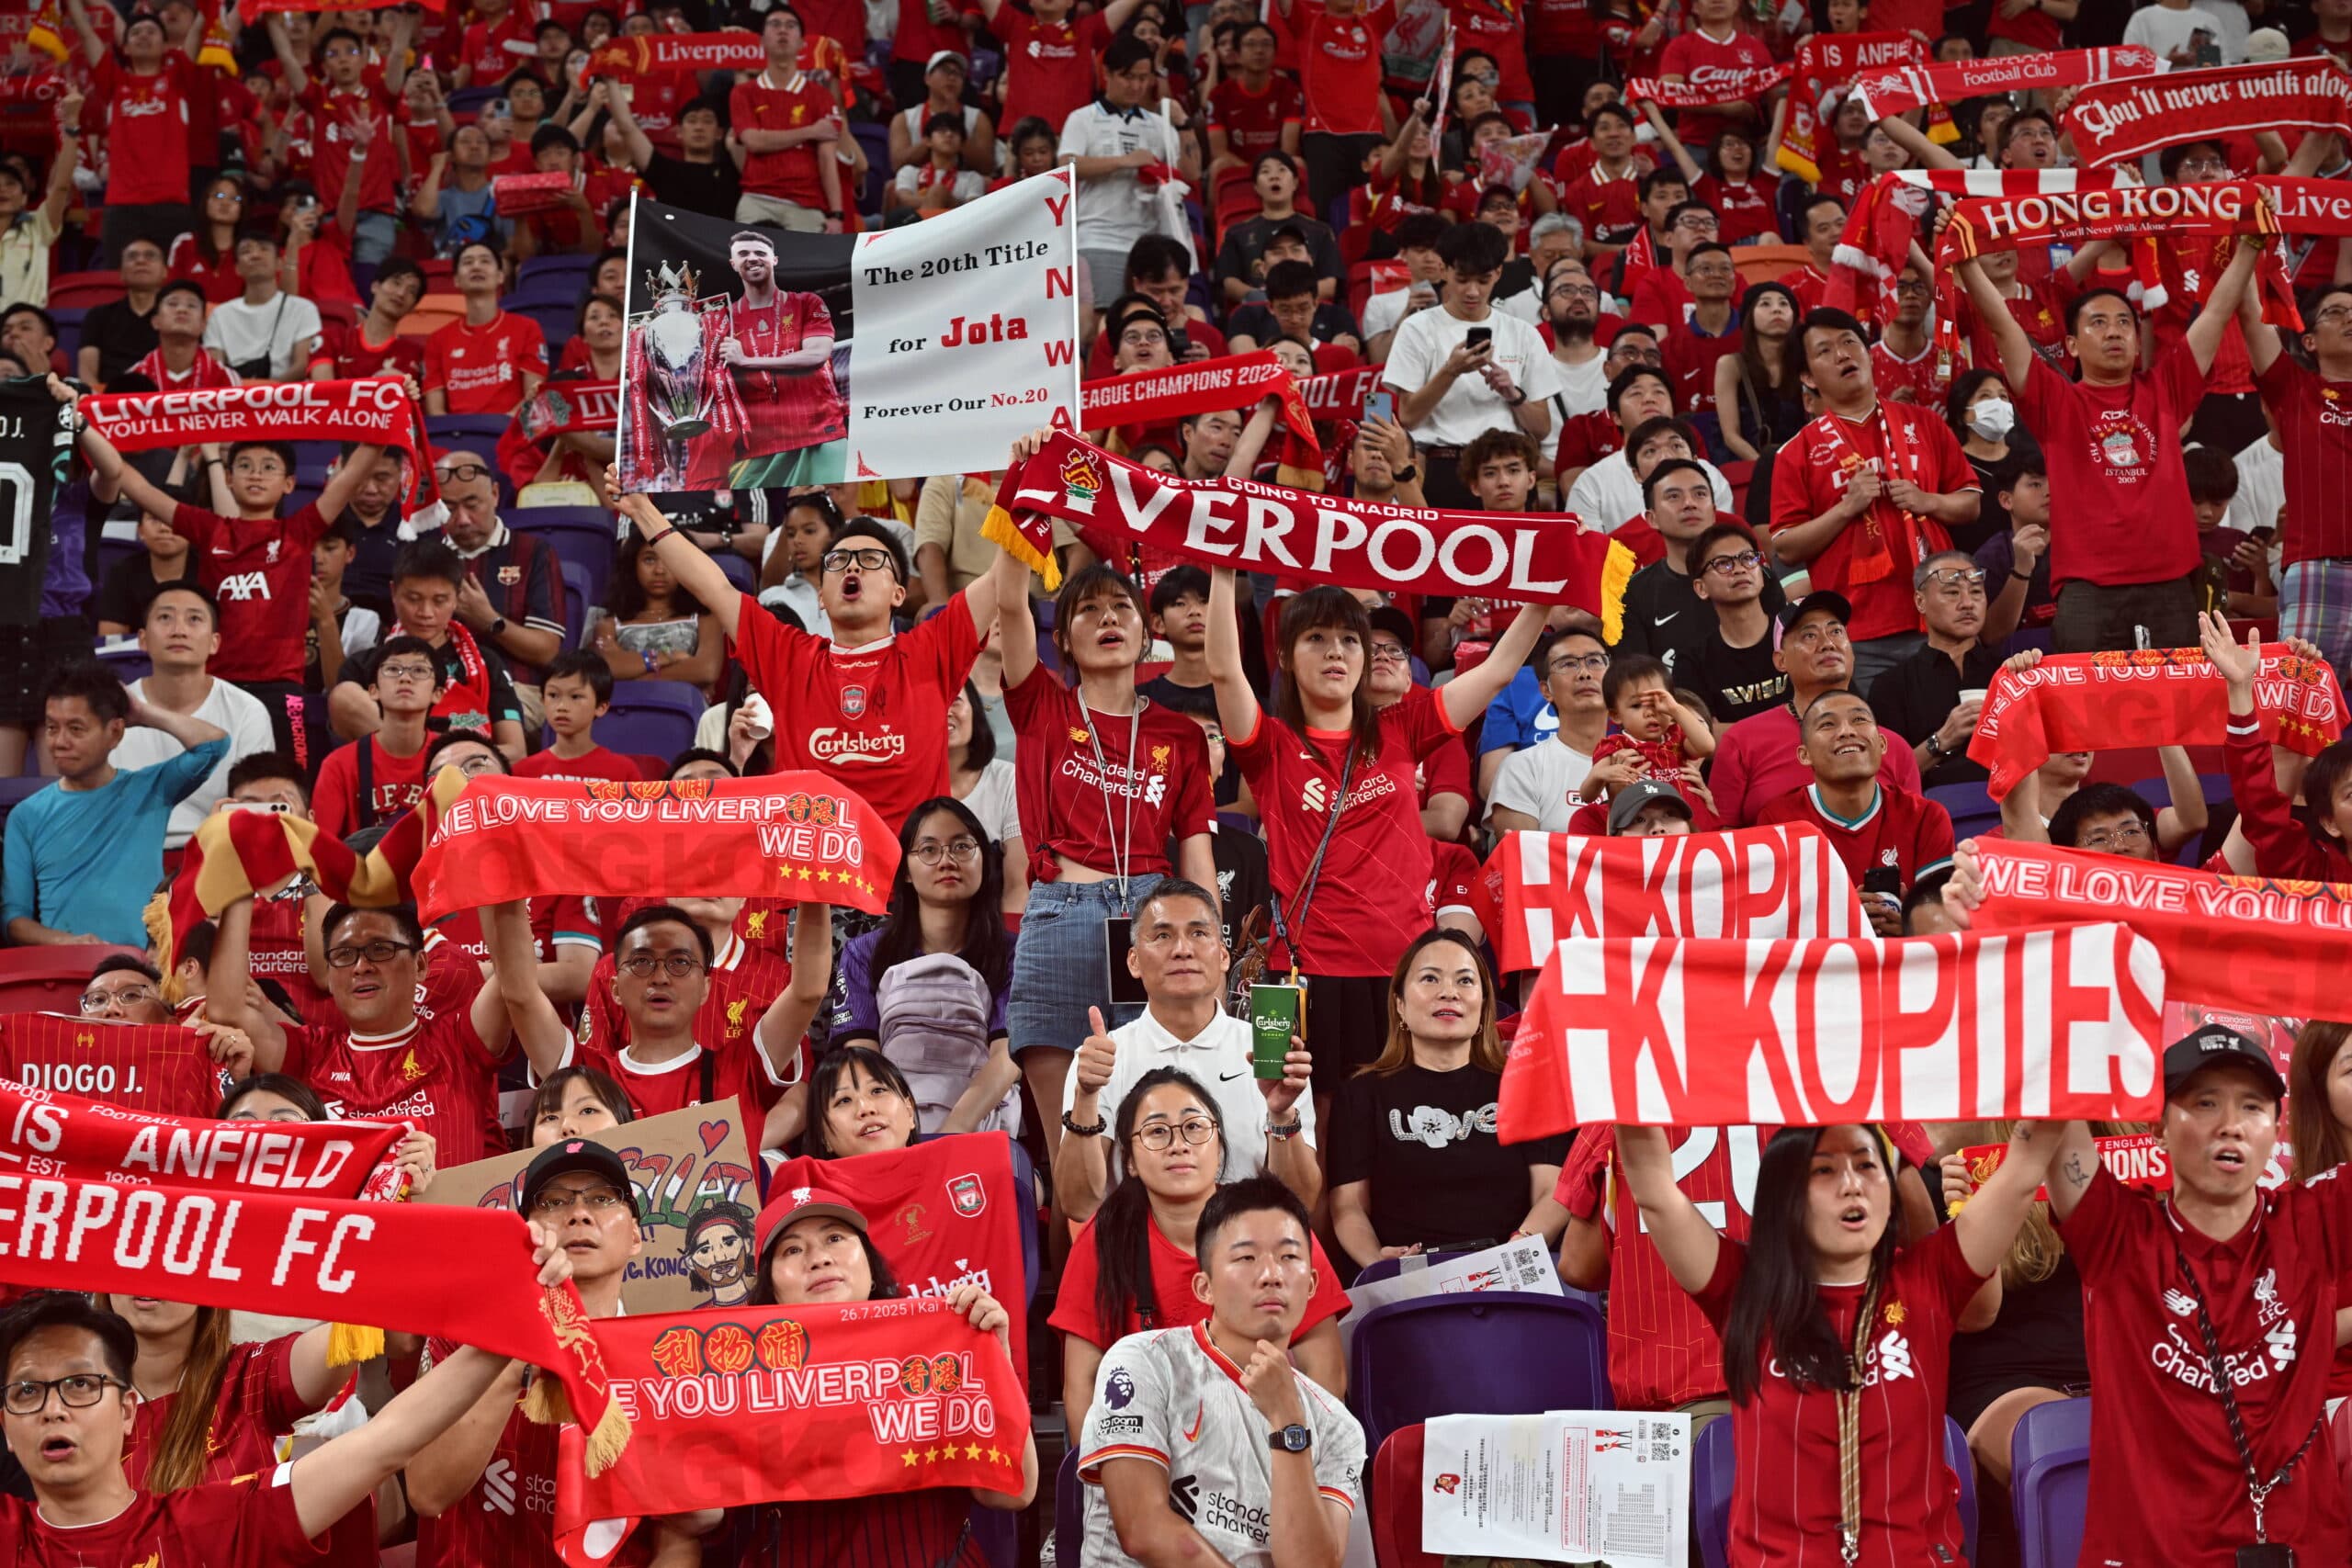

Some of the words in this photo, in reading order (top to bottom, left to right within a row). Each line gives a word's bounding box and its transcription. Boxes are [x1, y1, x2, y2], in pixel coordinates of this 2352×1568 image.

[1823, 45, 1842, 67] IS
[1962, 63, 2021, 86] Football
[2023, 62, 2057, 79] Club
[2073, 85, 2163, 147] You'll
[2164, 81, 2232, 109] never
[2237, 70, 2299, 100] walk
[1980, 192, 2110, 241] HONG
[2120, 186, 2241, 221] KONG
[2085, 224, 2113, 235] Never
[2114, 221, 2138, 233] Walk
[2139, 220, 2166, 232] Alone
[865, 266, 914, 286] The
[921, 253, 978, 278] 20th
[985, 241, 1049, 266] Title
[888, 337, 927, 353] for
[941, 313, 1028, 348] Jota
[91, 382, 330, 423] LIVERPOOL
[348, 380, 404, 411] FC
[864, 402, 944, 419] Forever
[948, 398, 986, 412] Our
[990, 388, 1048, 407] No.20
[1081, 383, 1130, 410] EAGUE
[1134, 368, 1231, 400] CHAMPIONS
[1238, 364, 1283, 386] 2025
[98, 414, 173, 439] YOU'LL
[180, 413, 245, 432] NEVER
[254, 409, 322, 426] WALK
[327, 410, 393, 429] ALONE
[2105, 468, 2148, 477] ISTANBUL
[1227, 477, 1297, 502] GOING
[1306, 494, 1337, 508] TO
[1347, 501, 1439, 522] MADRID
[1014, 459, 1568, 594] VERPOOL
[217, 570, 271, 601] AXA
[2255, 682, 2302, 713] WE
[808, 725, 905, 764] Carlsberg
[1062, 761, 1142, 798] Chartered
[477, 793, 570, 829] LOVE
[575, 798, 650, 823] YOU
[758, 824, 813, 861] WE
[823, 831, 864, 869] DO
[2054, 862, 2190, 915] LOVE
[2194, 879, 2306, 924] YOU
[248, 950, 305, 963] tandar
[250, 961, 309, 975] hartere
[1256, 1015, 1291, 1032] Carlsberg
[22, 1063, 116, 1093] DIOGO
[124, 1066, 143, 1094] J.
[88, 1104, 182, 1127] FOOTBALL
[11, 1100, 69, 1152] IS
[120, 1124, 355, 1189] ANFIELD
[2105, 1136, 2158, 1150] ENGLAN
[271, 1206, 376, 1293] FC
[645, 1256, 688, 1280] KONG
[841, 1303, 908, 1322] 26.7.2025
[918, 1300, 940, 1314] Kai
[651, 1319, 809, 1378] 利物浦
[643, 1371, 740, 1419] YOU
[869, 1398, 942, 1445] WE
[944, 1393, 996, 1439] DO
[1110, 1416, 1139, 1427] room
